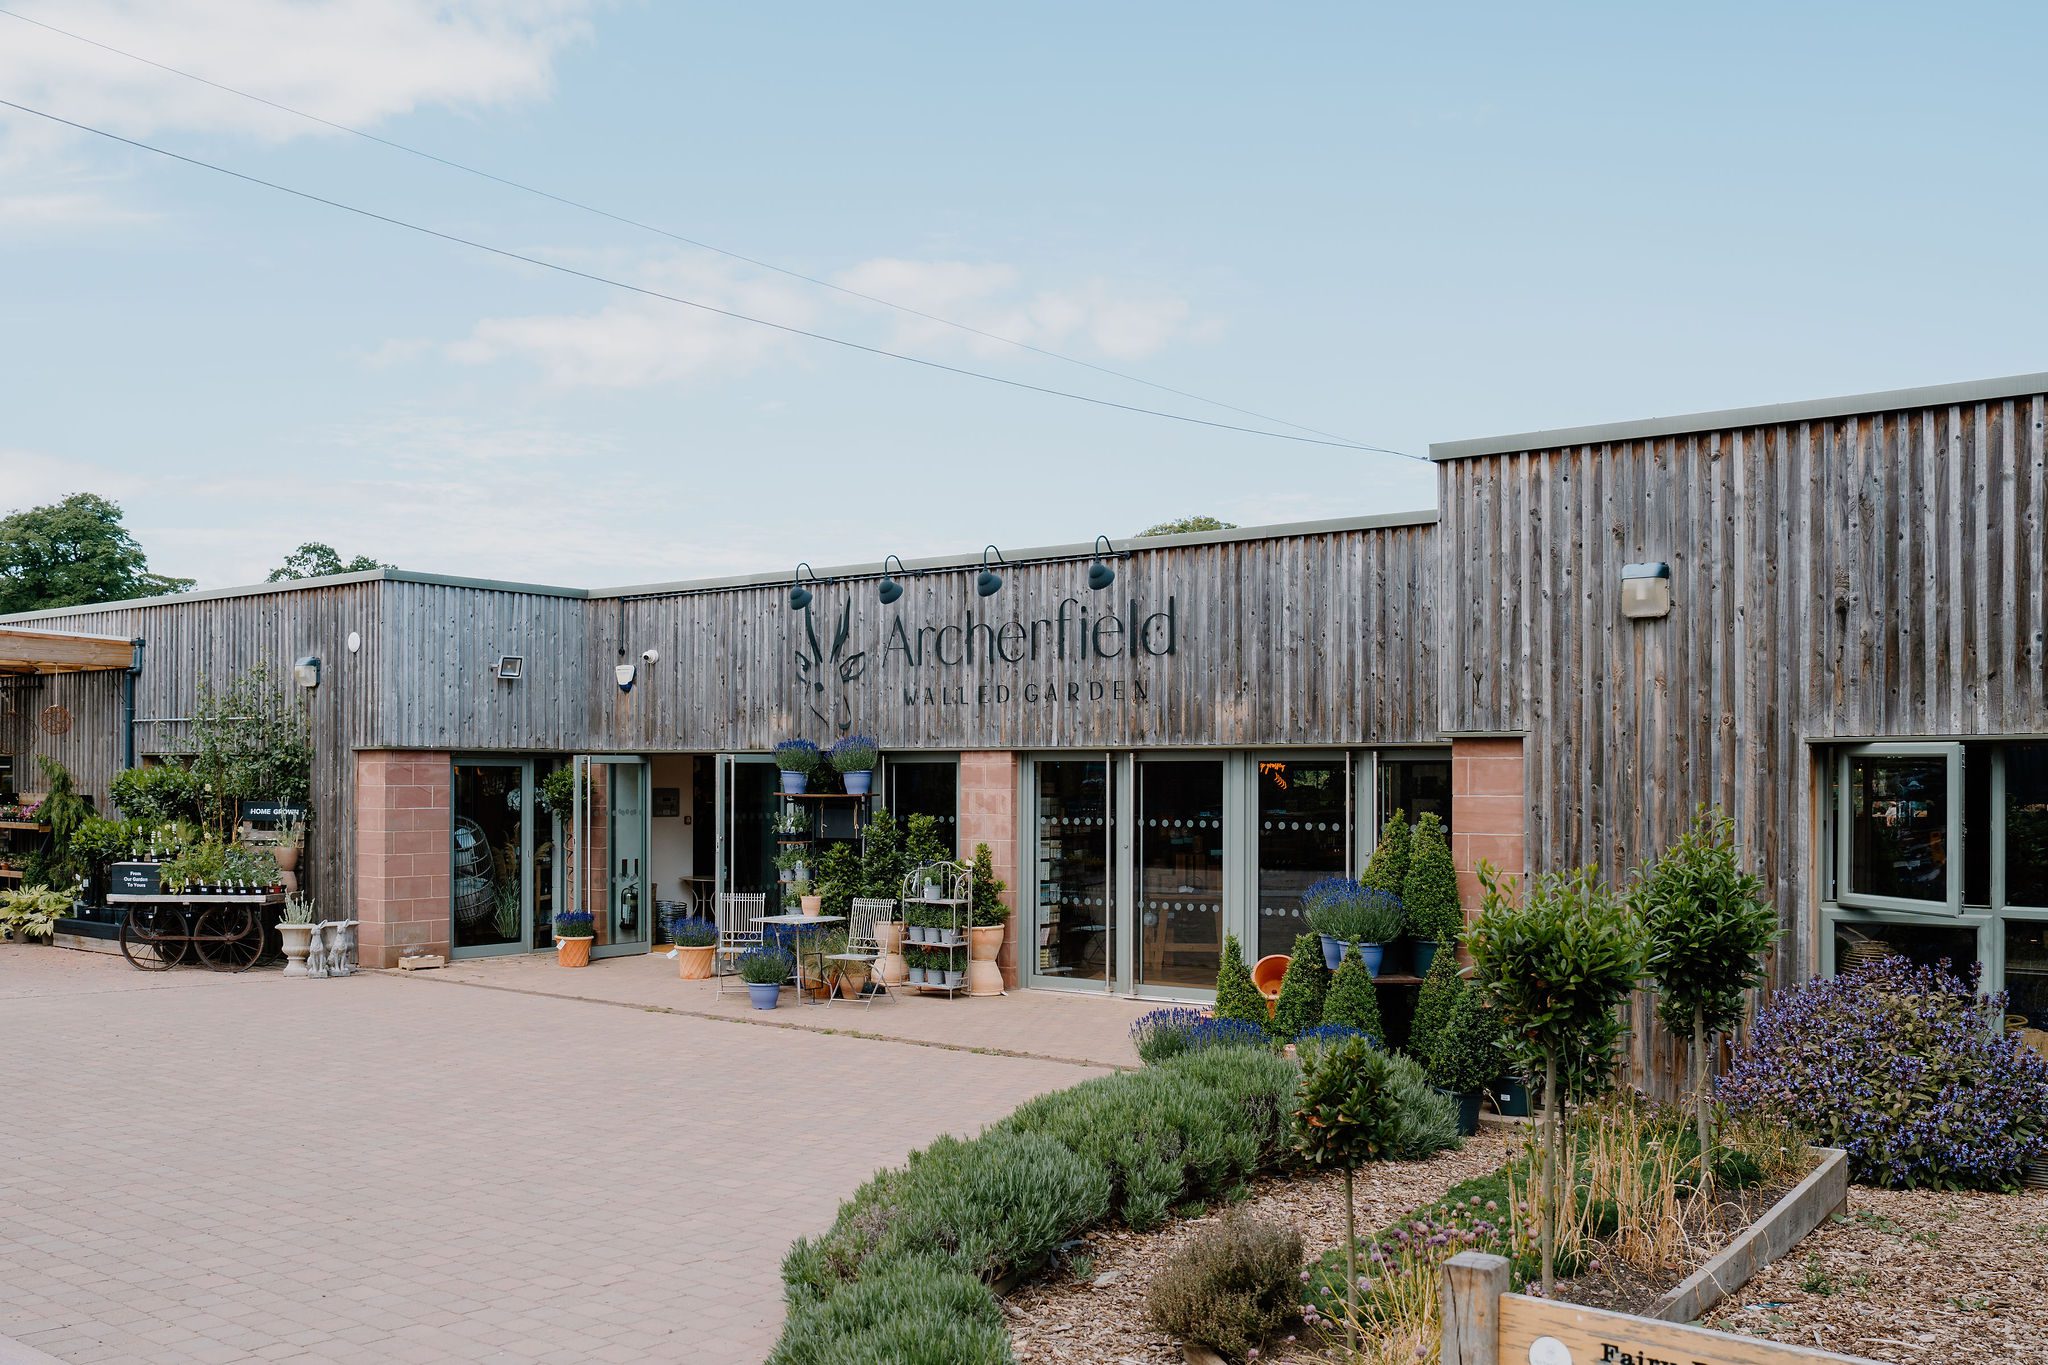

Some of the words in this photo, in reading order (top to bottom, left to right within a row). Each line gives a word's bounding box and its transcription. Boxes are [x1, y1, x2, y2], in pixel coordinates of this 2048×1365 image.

[882, 595, 1176, 668] Archerfield
[903, 684, 1010, 707] WALLED
[1024, 679, 1149, 704] GARDEN
[273, 808, 300, 816] GROWN
[1600, 1342, 1678, 1365] Fair
